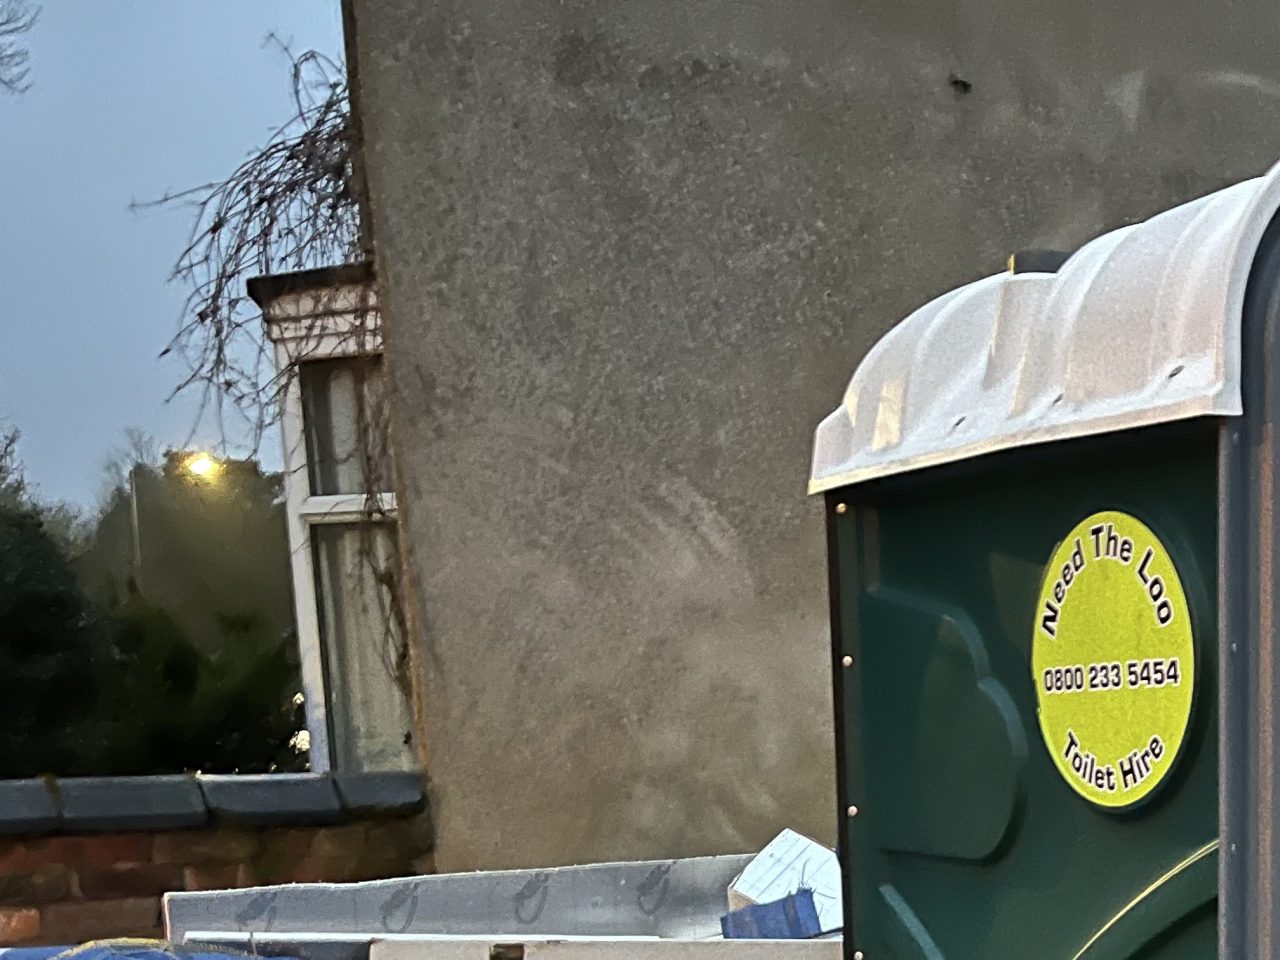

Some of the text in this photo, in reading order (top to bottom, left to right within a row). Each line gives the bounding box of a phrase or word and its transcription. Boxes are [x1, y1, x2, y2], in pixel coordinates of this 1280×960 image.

[1042, 525, 1172, 636] Need The Loo
[1045, 661, 1179, 691] 0800 233 5454
[1064, 732, 1163, 790] Toilet Hire
